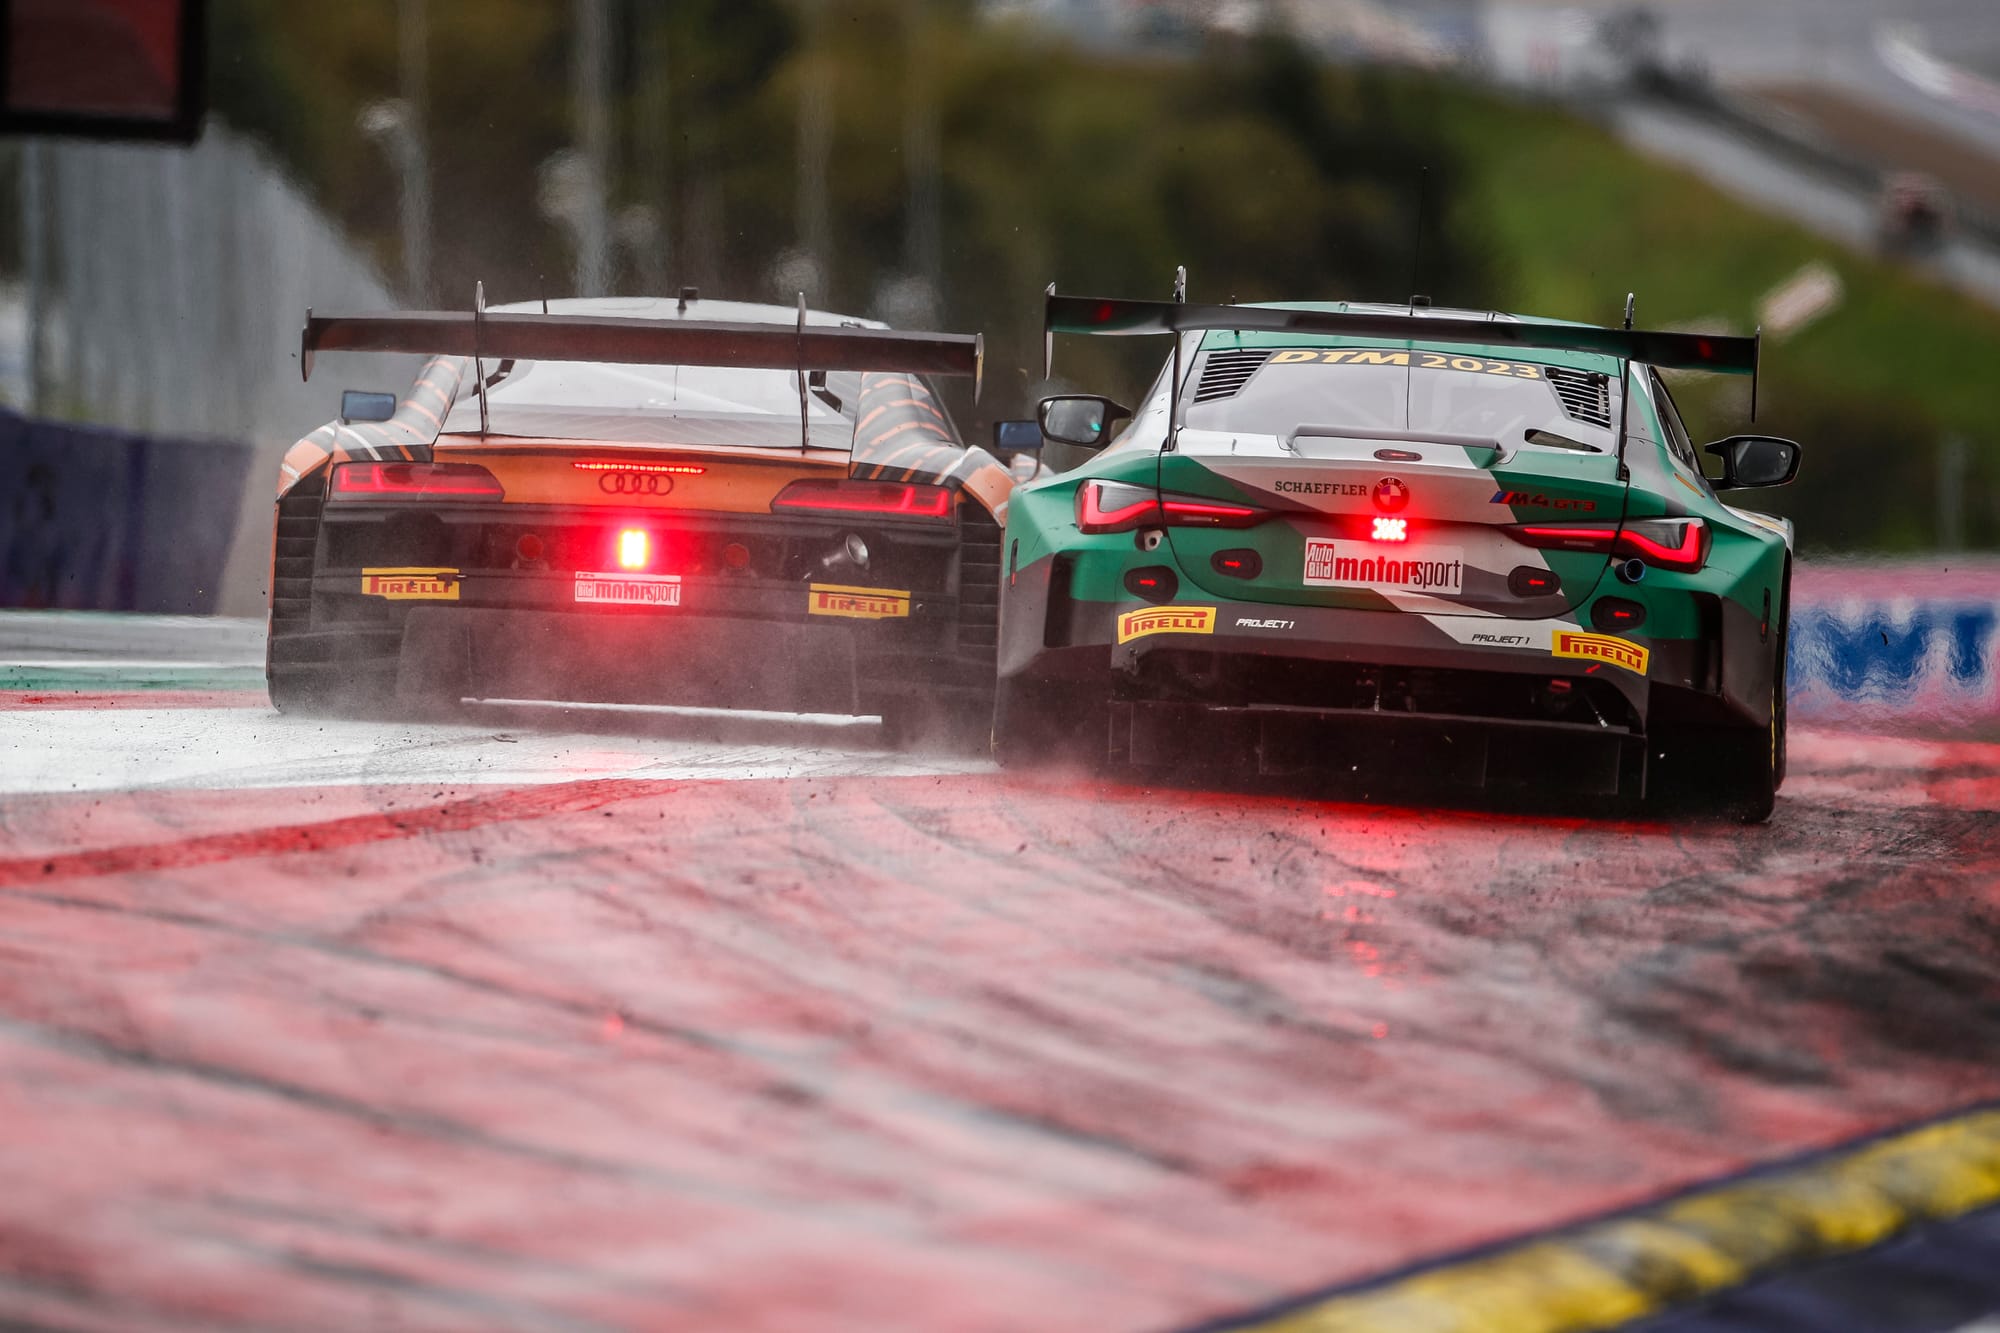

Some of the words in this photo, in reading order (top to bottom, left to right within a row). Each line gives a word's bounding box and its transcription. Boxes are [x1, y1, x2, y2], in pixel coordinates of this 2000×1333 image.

[1268, 350, 1410, 365] DTM
[1420, 354, 1541, 380] 2023
[1274, 480, 1368, 497] SCHAEFFLER
[1509, 492, 1550, 509] M4
[1552, 499, 1597, 513] GT3
[1307, 544, 1333, 562] Auto
[1335, 556, 1461, 589] motorsport
[818, 592, 900, 615] PIRELLI
[1124, 611, 1208, 637] PIRELLI
[1235, 618, 1289, 630] PROJECT
[1471, 633, 1525, 646] PROJECT
[1560, 634, 1644, 670] PIRELLI
[1788, 602, 1997, 702] WT
